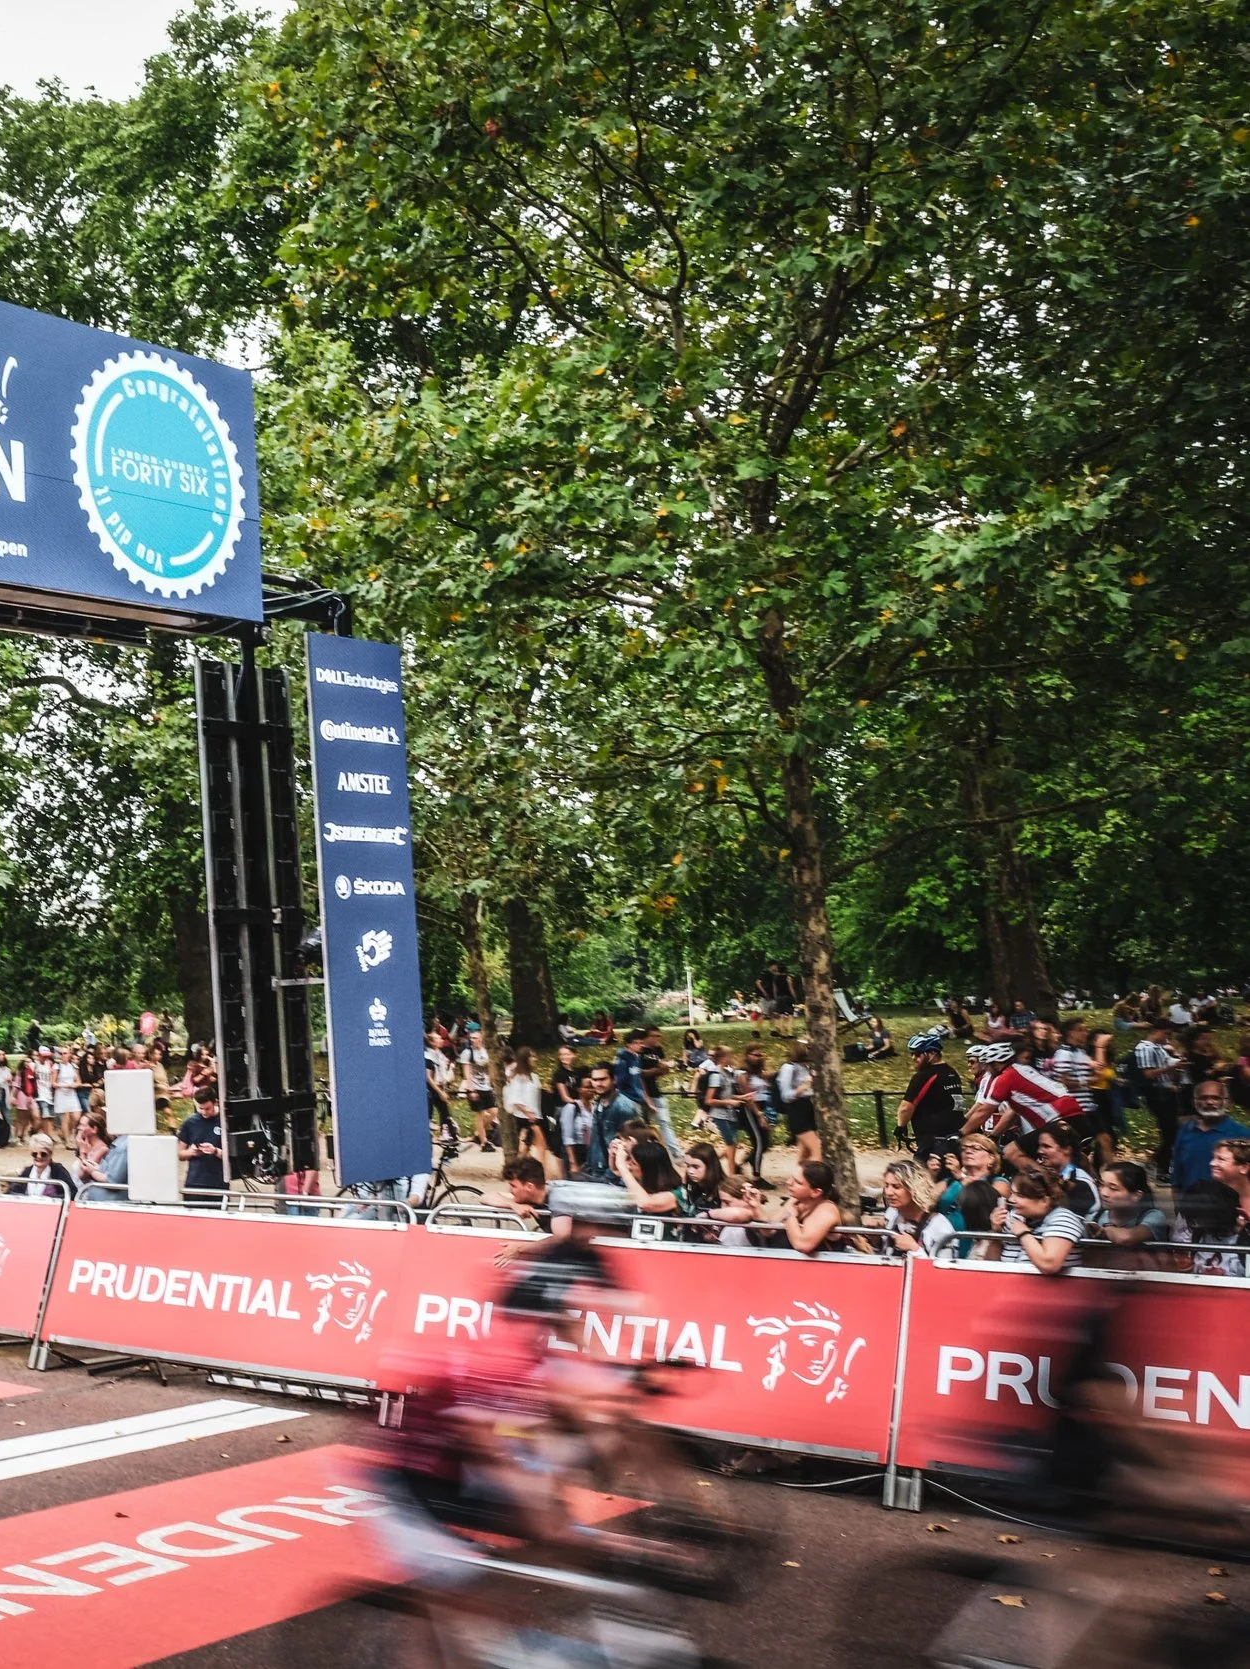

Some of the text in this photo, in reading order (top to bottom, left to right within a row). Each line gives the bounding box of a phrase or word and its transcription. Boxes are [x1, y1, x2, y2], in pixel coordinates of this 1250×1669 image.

[111, 456, 210, 498] FORTY SIX
[121, 377, 229, 526] Congratulations
[94, 484, 164, 574] You did it
[337, 771, 392, 795] AMSTEL
[353, 877, 406, 896] ŠKODA
[67, 1258, 301, 1321] PRUDENTIAL
